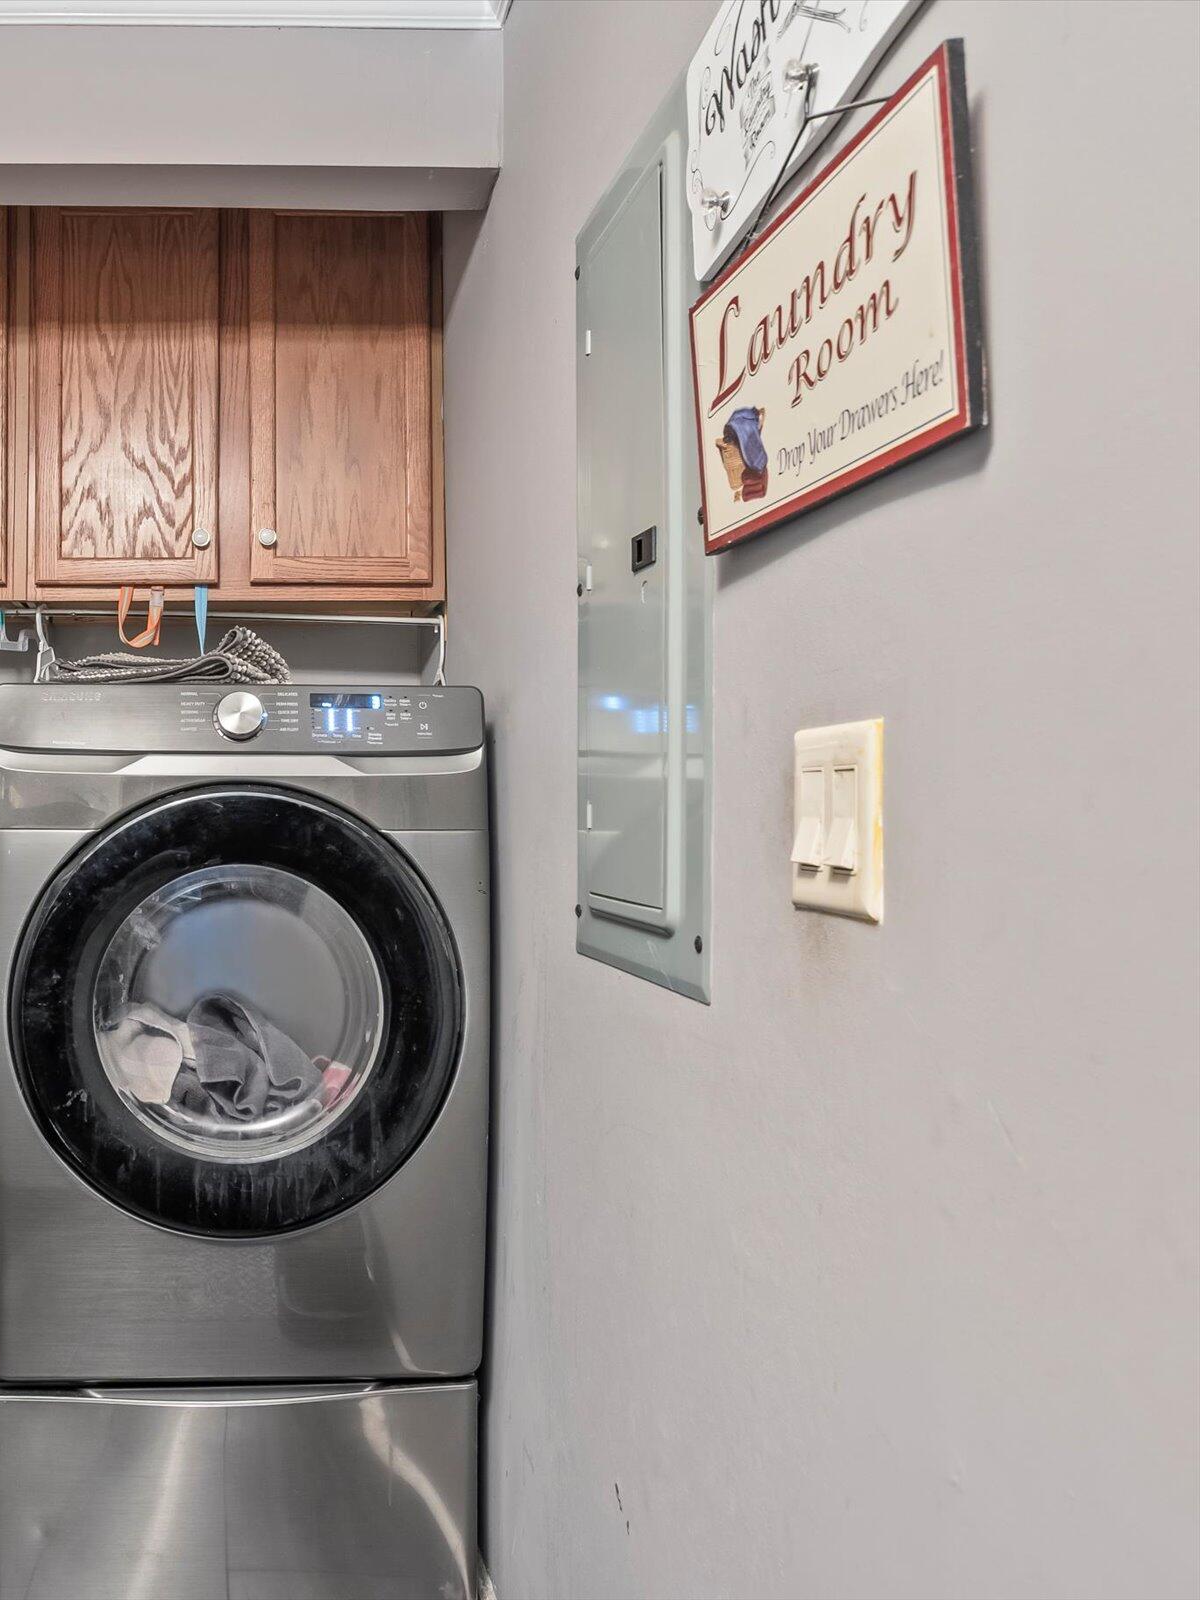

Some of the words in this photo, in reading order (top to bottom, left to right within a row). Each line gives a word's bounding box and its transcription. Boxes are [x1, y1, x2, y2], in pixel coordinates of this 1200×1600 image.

[708, 170, 917, 418] Laundry
[777, 443, 805, 476] Drop
[807, 422, 837, 464] Your
[838, 385, 899, 441] Drawers
[900, 349, 945, 406] Here!
